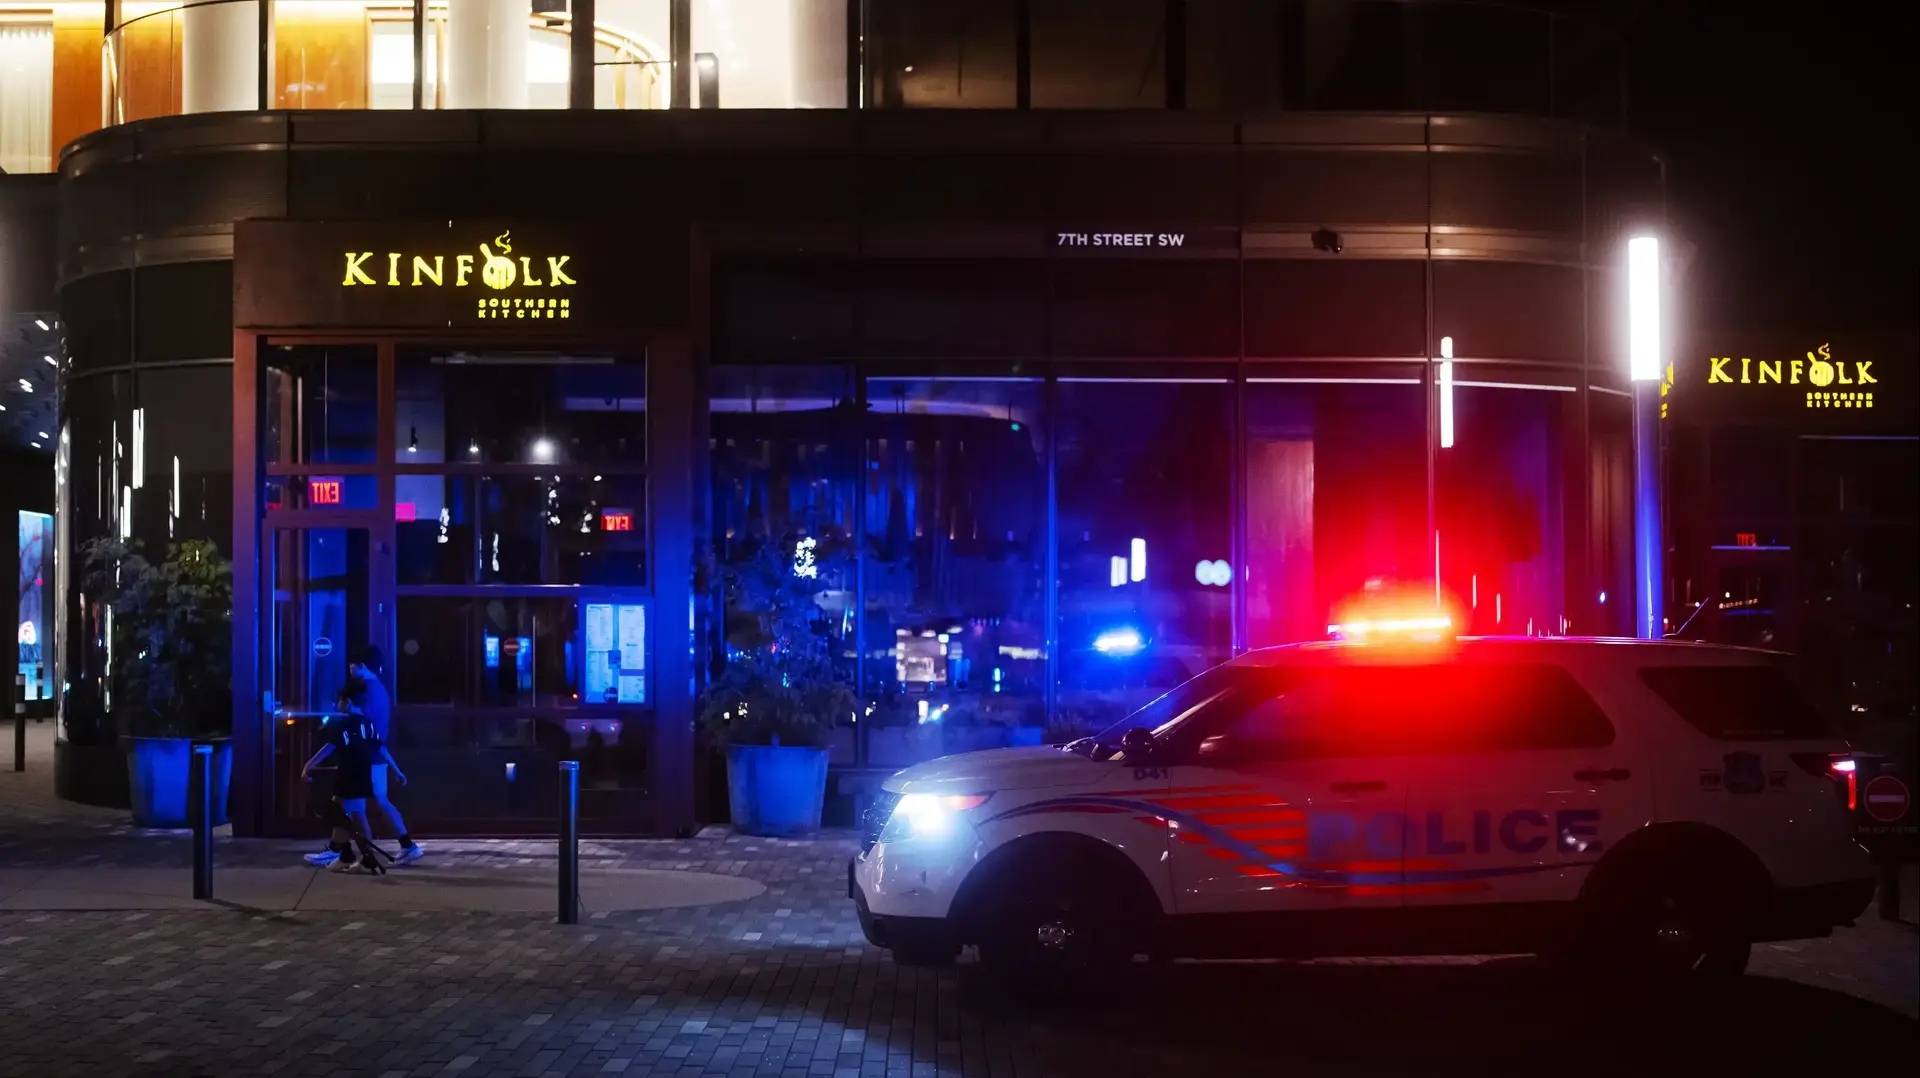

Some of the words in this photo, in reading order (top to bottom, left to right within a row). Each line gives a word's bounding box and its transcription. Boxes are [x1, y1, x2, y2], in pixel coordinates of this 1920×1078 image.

[1058, 233, 1088, 246] 7TH
[1093, 233, 1153, 246] STREET
[1158, 233, 1185, 246] SW
[343, 242, 576, 290] KINFOLK
[478, 298, 570, 308] SOUTHERN
[478, 309, 570, 319] KITCHEN
[1708, 352, 1877, 387] KINFOLK
[1806, 392, 1873, 400] SOUTHERN
[1806, 400, 1873, 408] KITCHEN
[1308, 808, 1602, 858] POLICE
